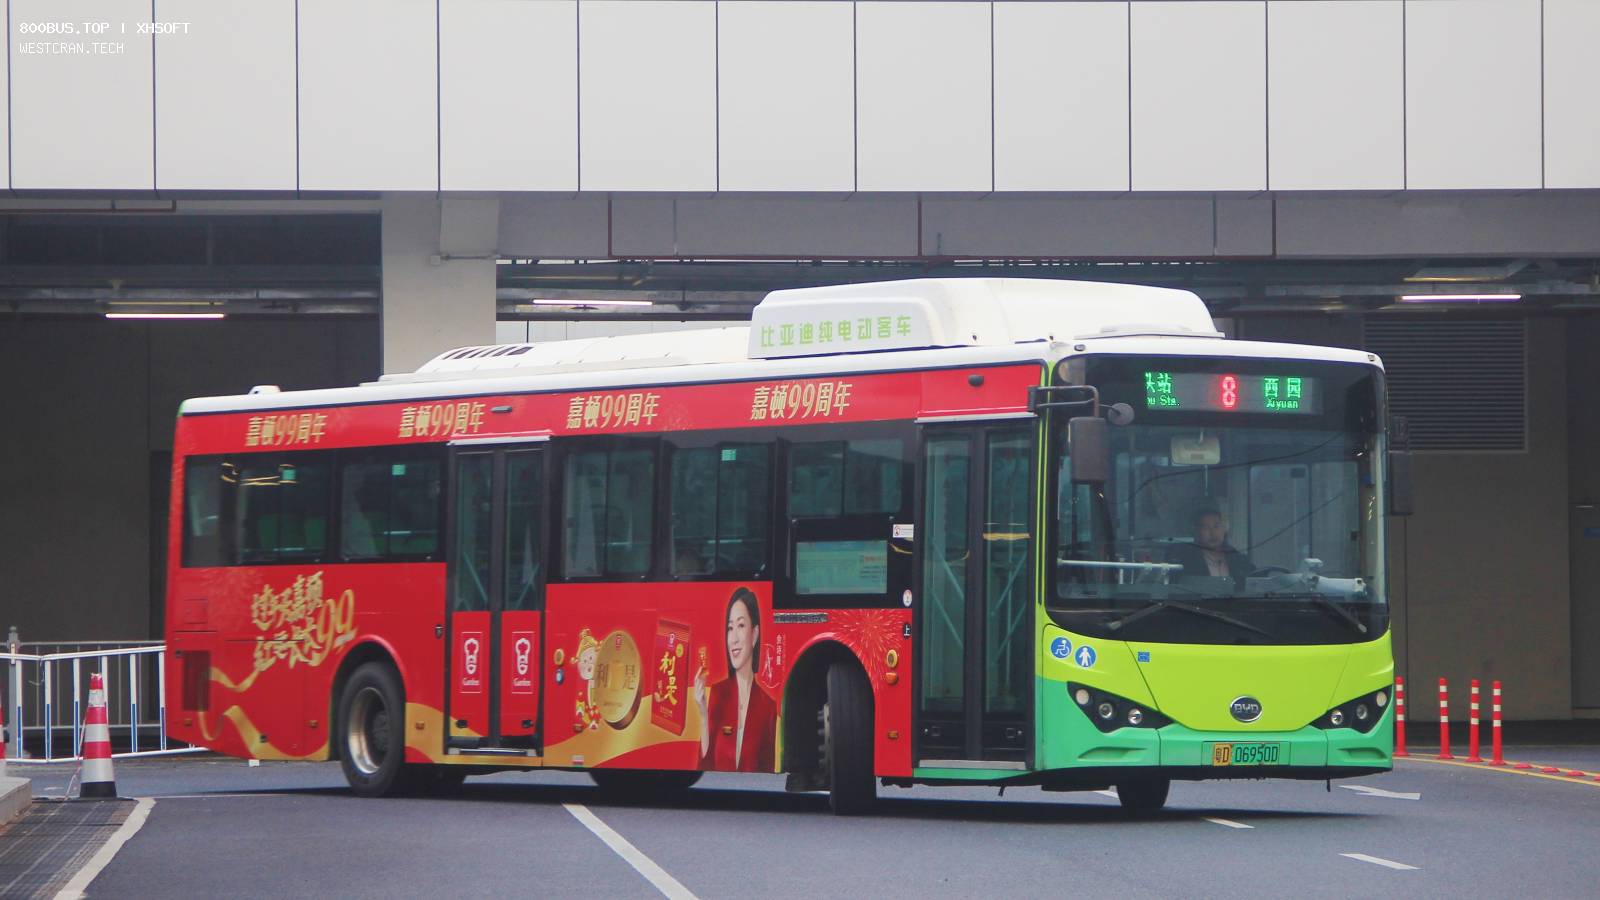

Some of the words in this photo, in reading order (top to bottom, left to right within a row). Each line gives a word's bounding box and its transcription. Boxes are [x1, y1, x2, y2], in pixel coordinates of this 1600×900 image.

[760, 315, 911, 348] 比亚迪纯电动客车
[750, 381, 852, 421] 嘉顿99周年
[1221, 375, 1237, 408] 8
[1264, 377, 1301, 398] 西园
[398, 402, 486, 438] 嘉顿99周年
[566, 393, 661, 429] 嘉顿99周年
[245, 412, 328, 447] 嘉顿99周年
[1234, 703, 1259, 713] BYD
